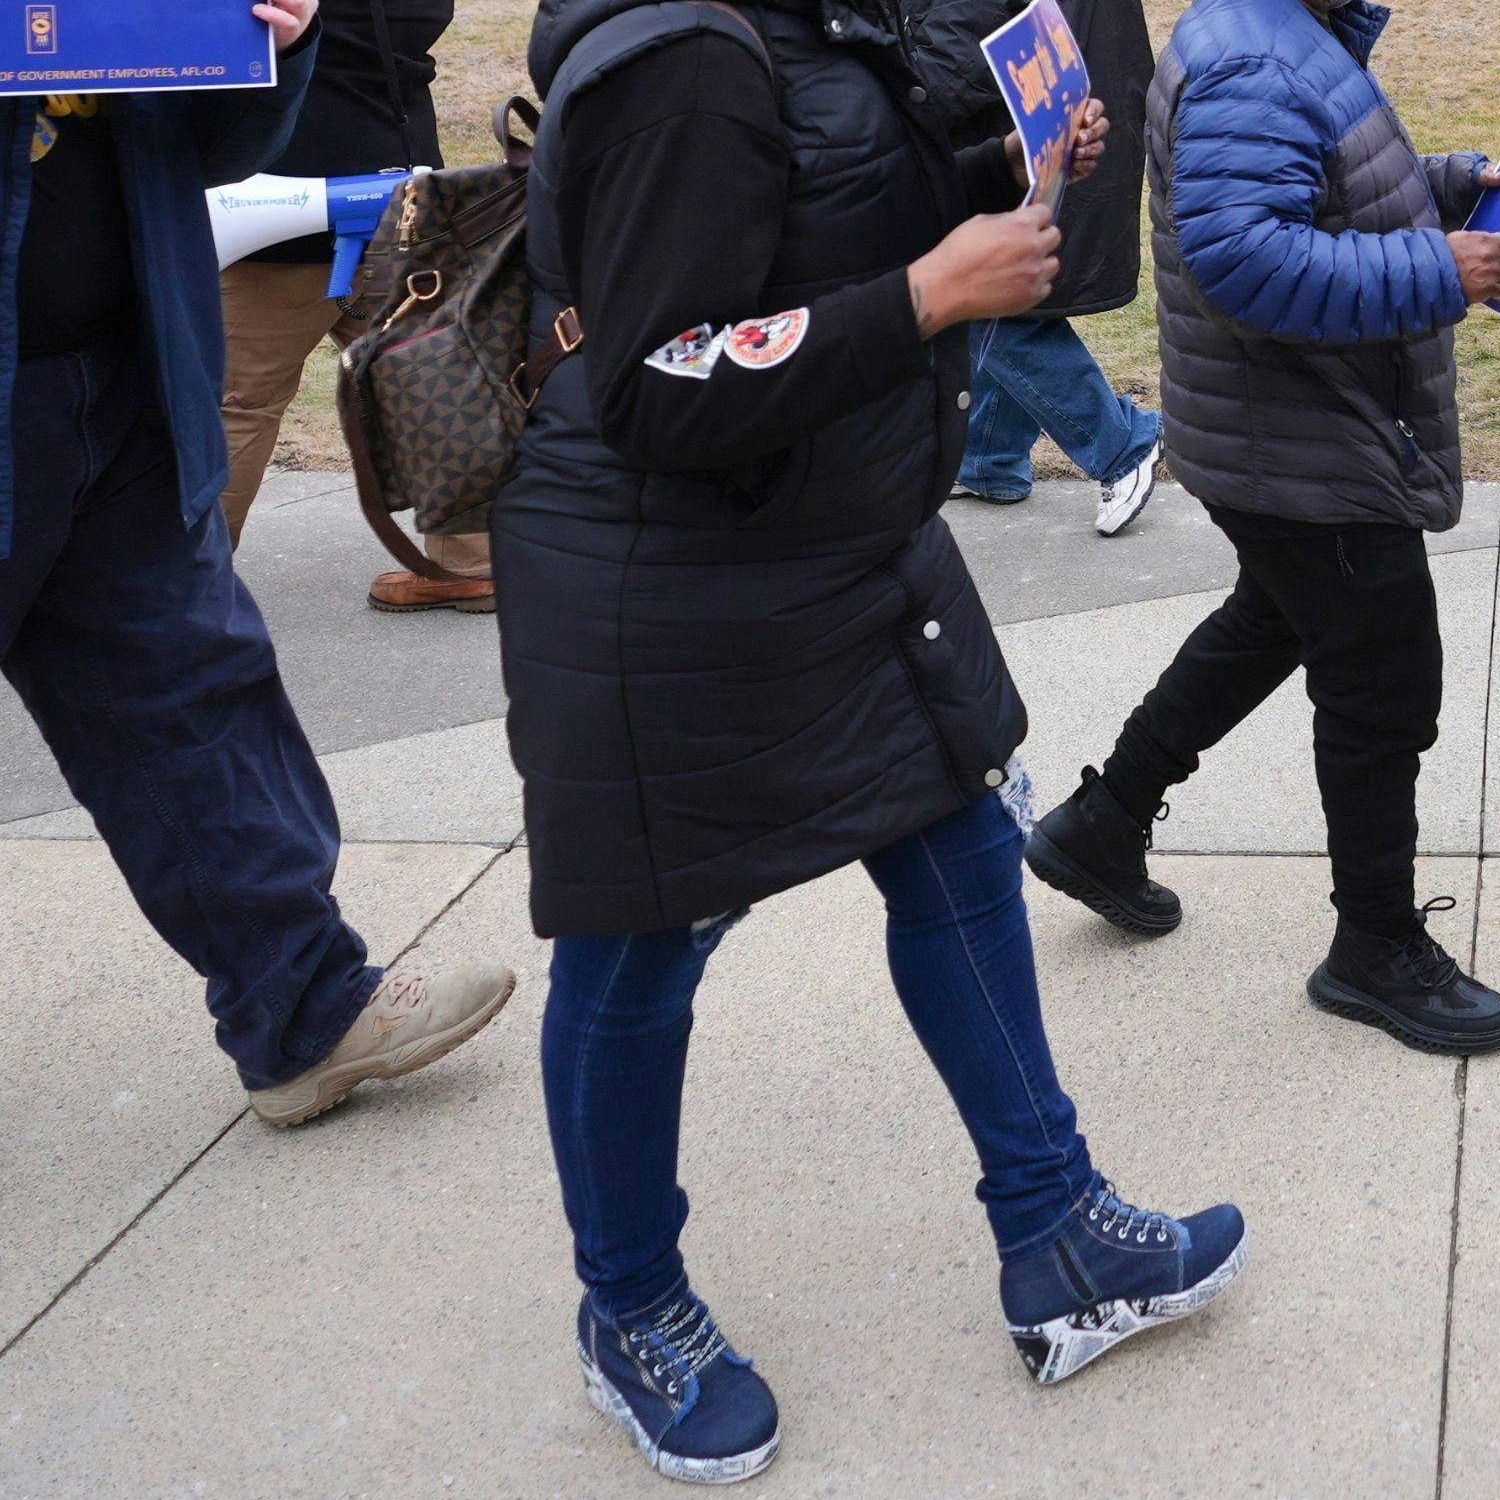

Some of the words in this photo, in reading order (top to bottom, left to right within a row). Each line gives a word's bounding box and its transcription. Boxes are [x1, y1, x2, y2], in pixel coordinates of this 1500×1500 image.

[0, 71, 14, 82] OF
[17, 69, 107, 82] GOVERNMENT
[108, 67, 178, 79] EMPLOYEES,
[180, 66, 226, 77] AFL-CIO
